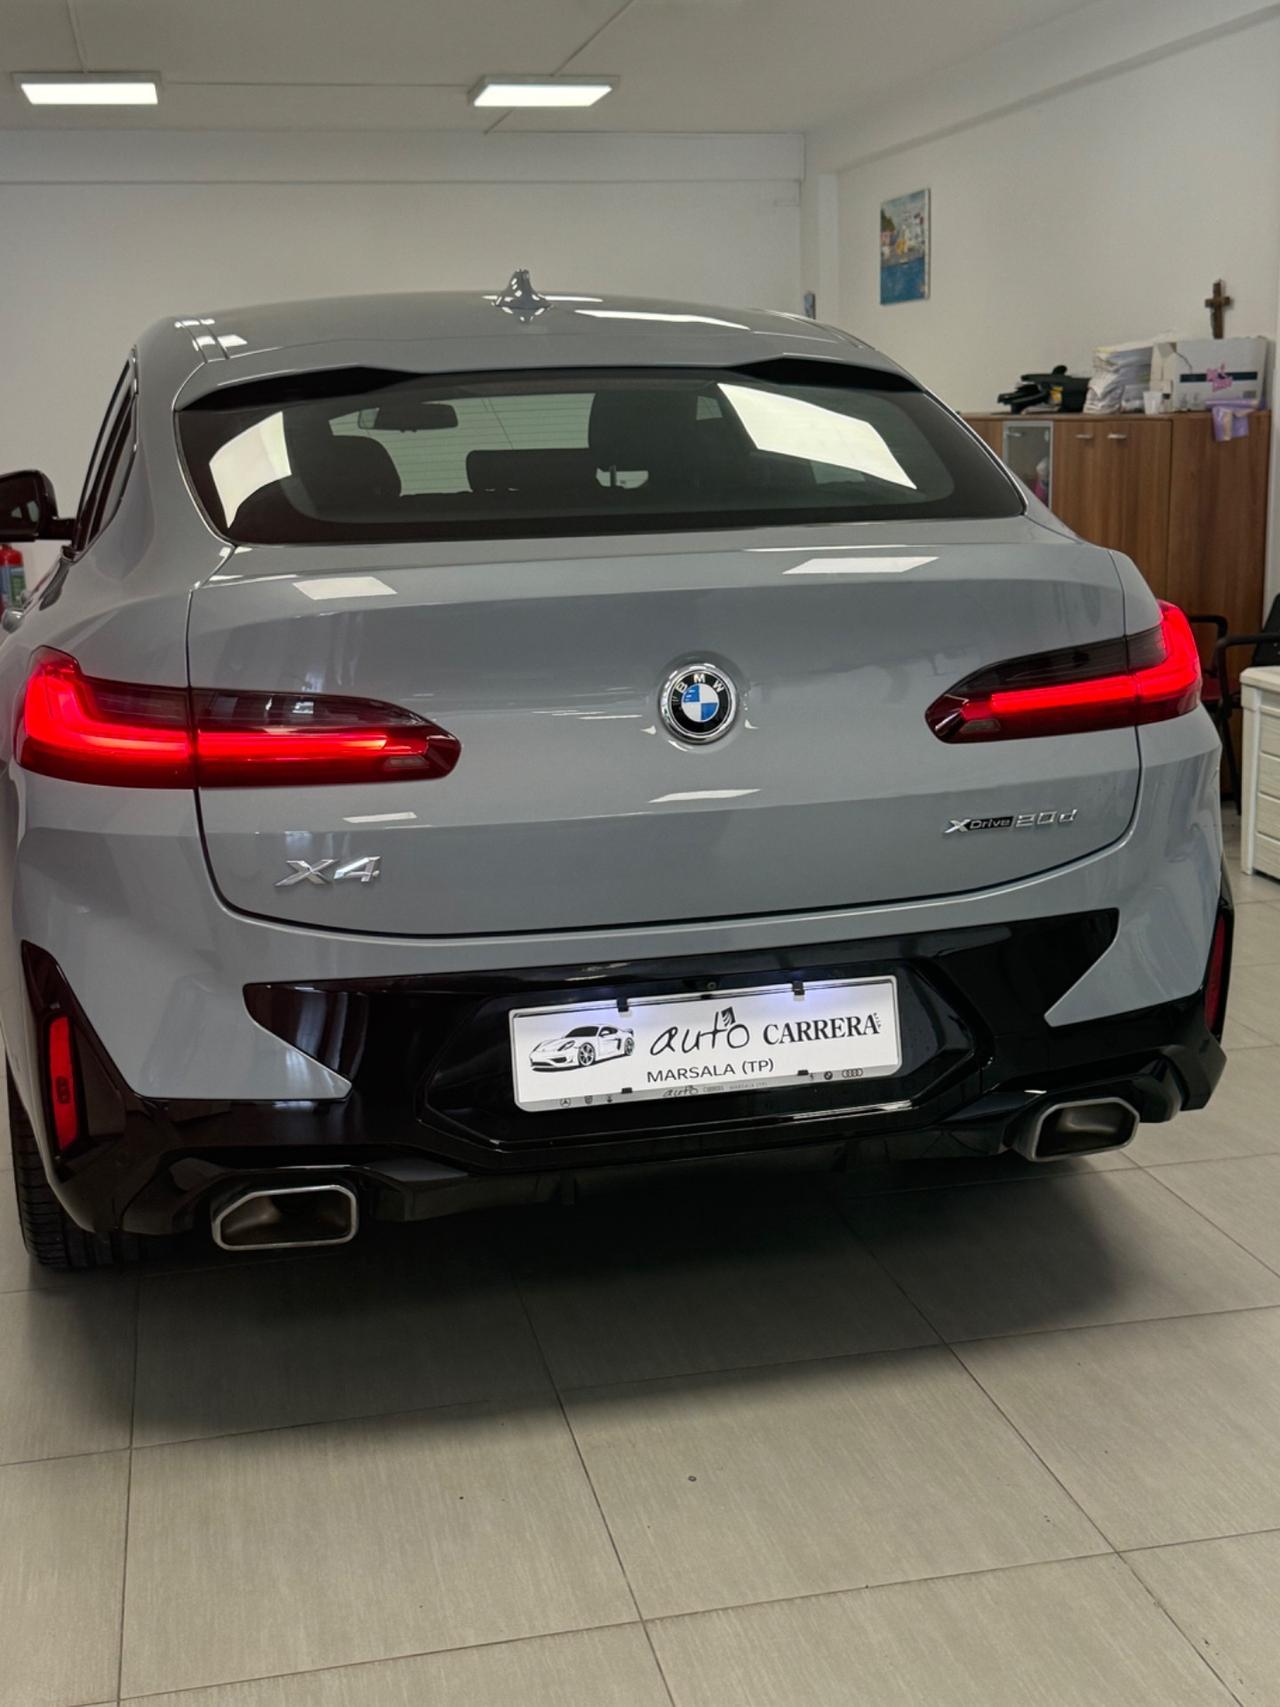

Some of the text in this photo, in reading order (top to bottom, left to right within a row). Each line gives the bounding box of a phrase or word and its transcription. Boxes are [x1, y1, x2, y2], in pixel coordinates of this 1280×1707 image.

[675, 673, 724, 693] BMW
[1016, 809, 1078, 828] 20d
[274, 856, 381, 887] X4
[650, 1008, 750, 1056] auto
[763, 1014, 880, 1045] CARRERA
[647, 1058, 774, 1083] MARSALA (TP)
